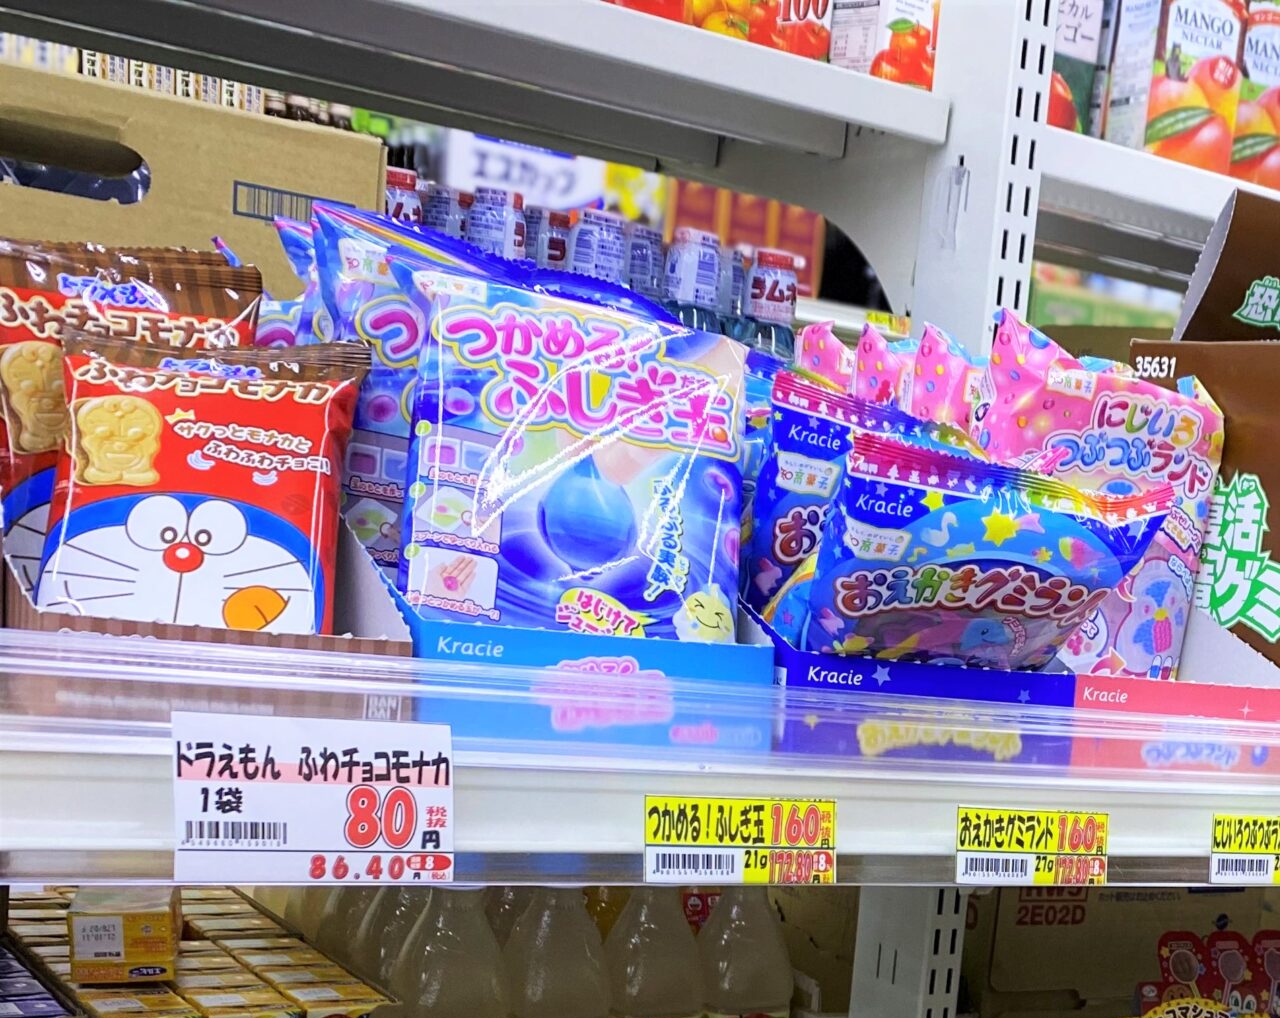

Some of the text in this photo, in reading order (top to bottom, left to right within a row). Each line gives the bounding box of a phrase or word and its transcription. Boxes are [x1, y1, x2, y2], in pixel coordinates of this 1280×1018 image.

[1174, 5, 1234, 37] MANGO
[1181, 30, 1224, 50] NECTAR
[1135, 356, 1177, 378] 35631
[76, 362, 333, 404] ふわチョコモナカ
[494, 358, 735, 449] ふしぎ玉
[1097, 397, 1202, 446] にじいろ
[176, 421, 312, 454] サクっとモナカと
[787, 423, 842, 451] Kracie
[1053, 434, 1212, 496] つぶつぶランド
[780, 467, 830, 493] 知育菓子
[854, 493, 914, 519] Kracie
[846, 534, 900, 558] 知育菓子
[436, 637, 505, 658] Kracie
[807, 666, 863, 687] Kracie
[1082, 686, 1129, 705] Kracie
[176, 740, 450, 787] ドラえもん ふわチョコモナカ
[200, 786, 244, 814] 1袋
[344, 784, 417, 849] 80
[770, 803, 822, 846] 160
[959, 811, 1055, 850] おえかきグミランド
[421, 830, 441, 850] 円
[1056, 814, 1098, 853] 160
[308, 853, 406, 881] 86.40
[744, 849, 768, 869] 21g
[768, 849, 814, 884] 172.80
[1034, 855, 1054, 873] 27g
[1015, 904, 1087, 927] 2E02D
